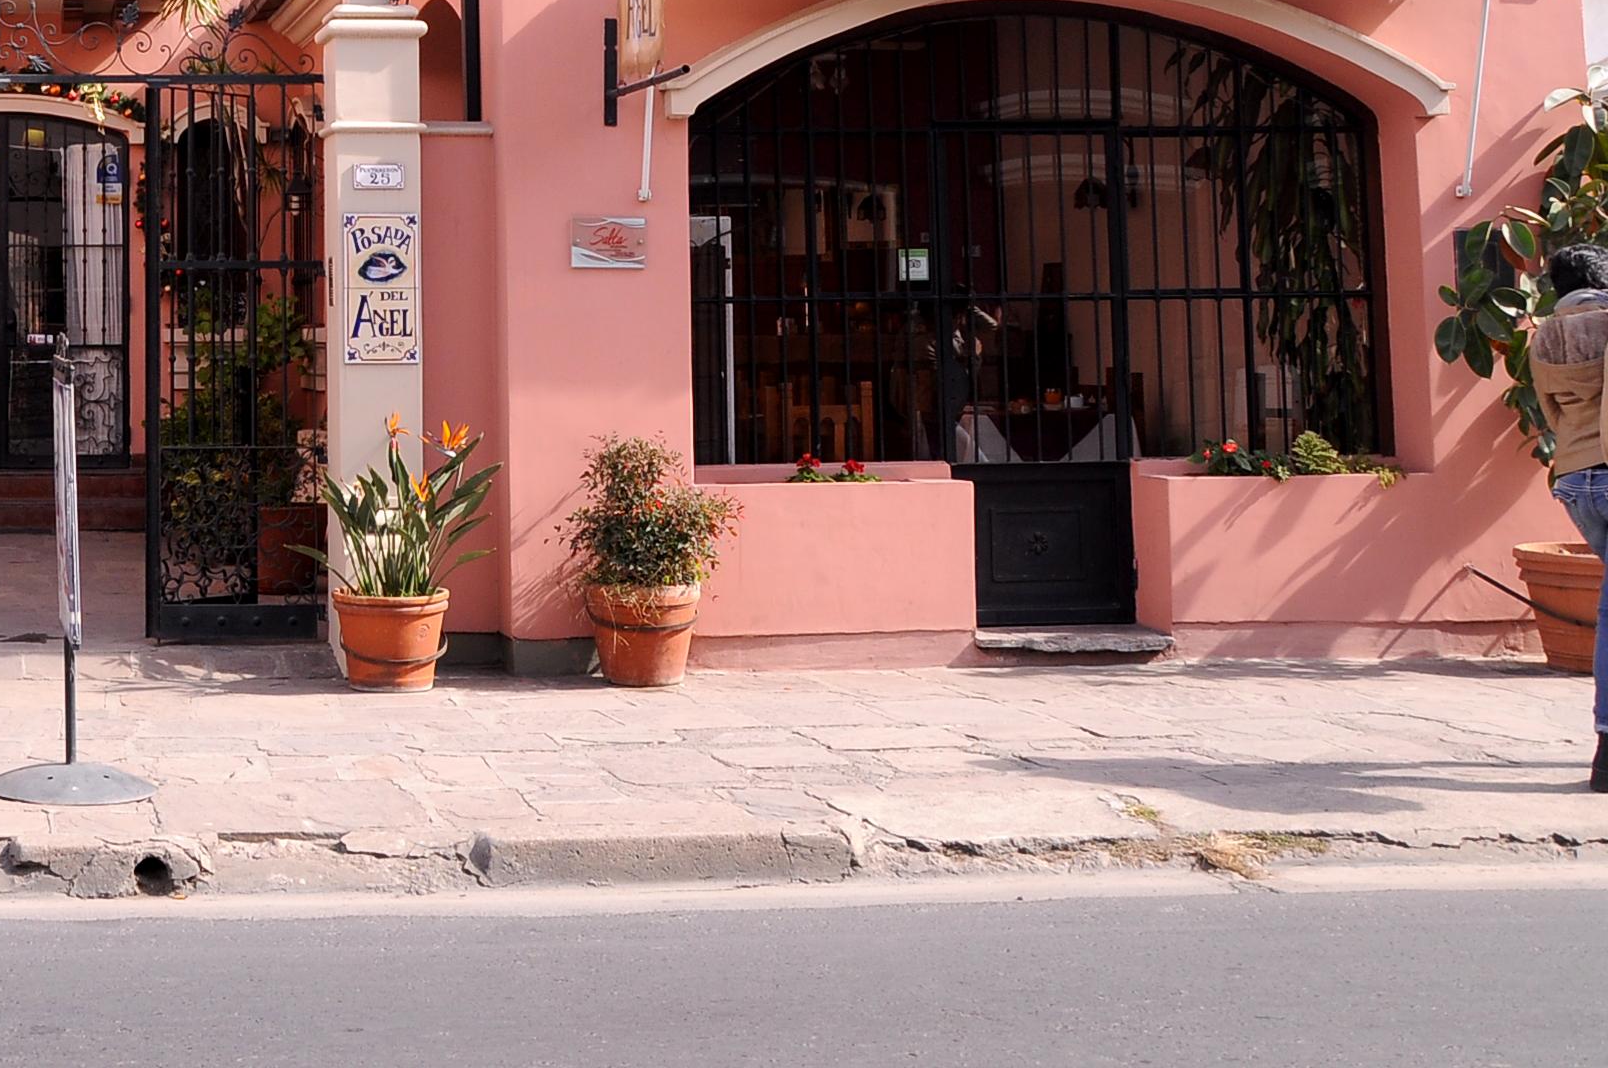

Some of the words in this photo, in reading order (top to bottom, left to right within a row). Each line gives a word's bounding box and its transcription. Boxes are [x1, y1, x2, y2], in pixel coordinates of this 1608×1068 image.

[369, 172, 391, 185] 25
[351, 226, 412, 255] POSADA
[380, 291, 408, 301] DEL
